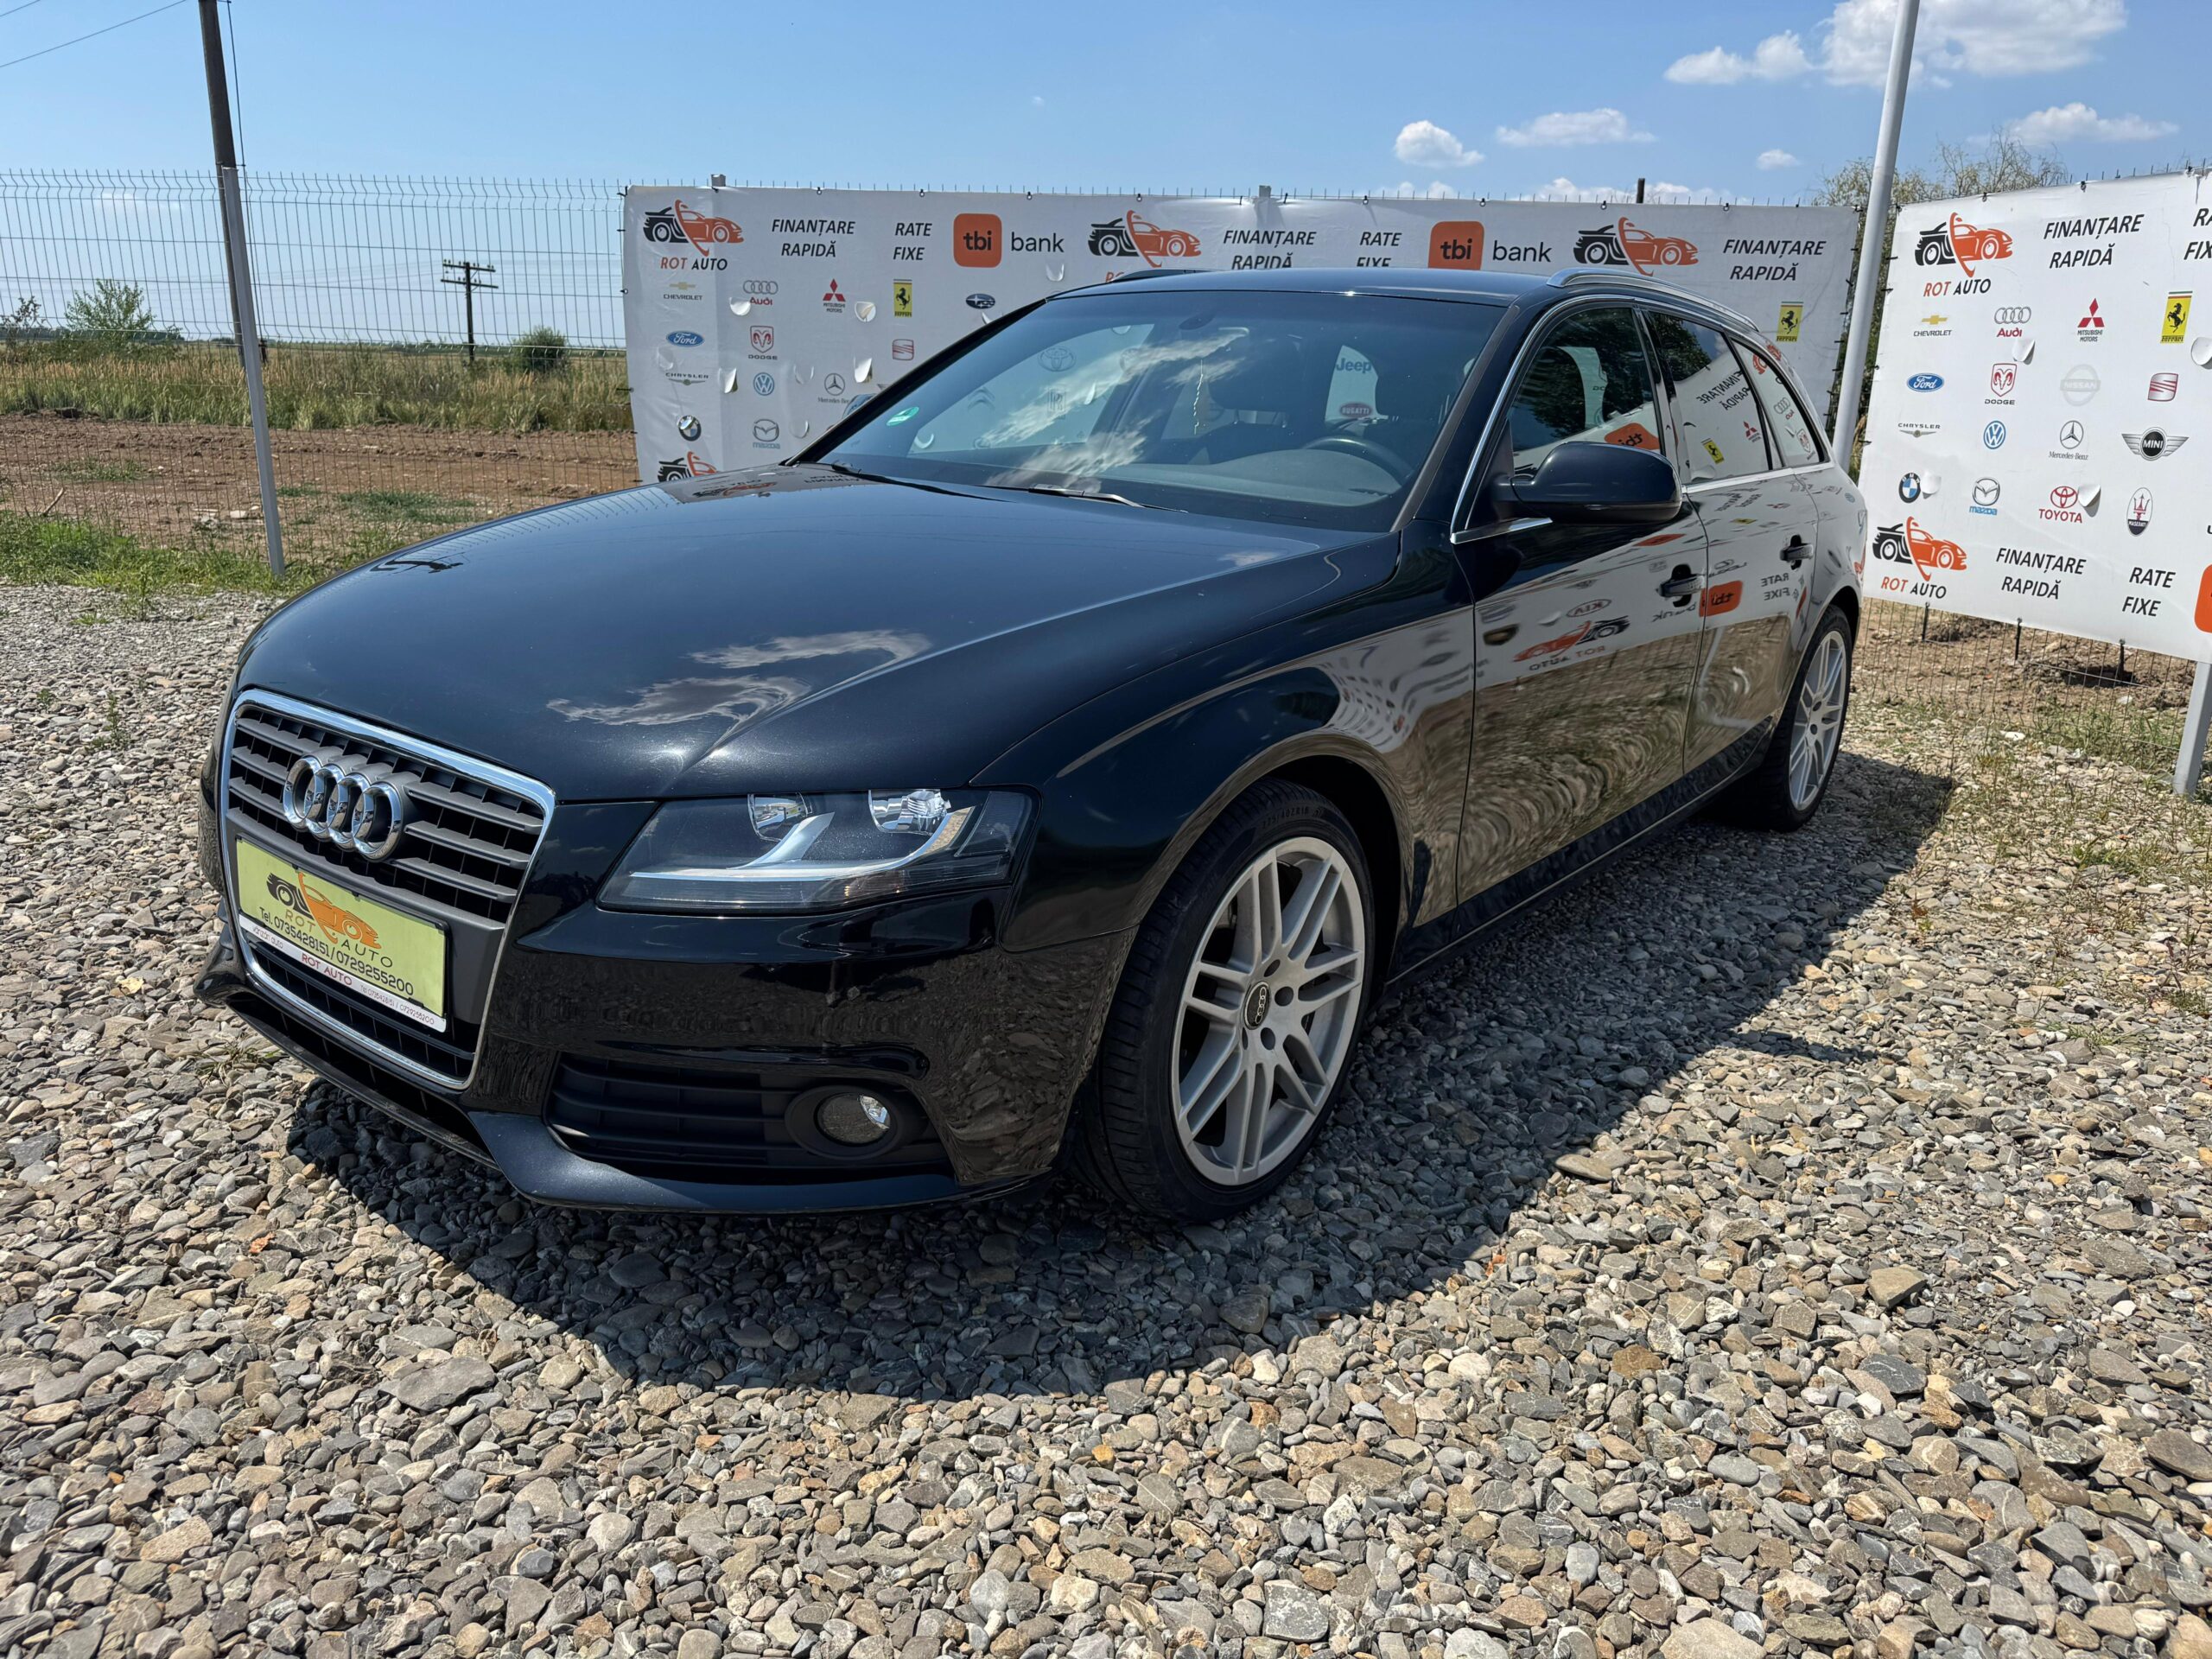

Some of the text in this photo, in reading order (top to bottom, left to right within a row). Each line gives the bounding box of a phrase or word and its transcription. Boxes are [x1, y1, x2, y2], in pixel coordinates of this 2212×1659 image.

[772, 219, 855, 237] FINANȚARE
[895, 222, 932, 237] RATE
[2044, 214, 2145, 239] FINANȚARE
[781, 240, 836, 257] RAPIDĂ
[963, 231, 1065, 253] tbi bank
[1224, 230, 1316, 248] FINANȚARE
[1359, 232, 1402, 247] RATE
[1723, 238, 1826, 259] FINANȚARE
[893, 246, 925, 261] FIXE
[1440, 238, 1552, 263] tbi bank
[2049, 243, 2115, 269] RAPIDĂ
[2183, 241, 2212, 260] FIX
[660, 257, 728, 270] ROT AUTO
[1231, 251, 1293, 270] RAPIDĂ
[1730, 262, 1798, 281] RAPIDĂ
[1923, 278, 1992, 297] ROT AUTO
[672, 332, 697, 346] Ford
[1997, 327, 2023, 338] Audi
[1336, 358, 1372, 374] Jeep
[1913, 375, 1936, 389] Ford
[2141, 439, 2164, 449] MINI
[2038, 508, 2083, 524] TOYOTA
[1995, 547, 2087, 575] FINANȚARE
[2128, 566, 2177, 588] RATE
[1880, 576, 1947, 600] ROT AUTO
[2001, 575, 2062, 600] RAPIDĂ
[2121, 595, 2162, 617] FIXE
[285, 909, 316, 932] ROT
[341, 939, 392, 968] AUTO
[302, 953, 353, 986] ROT AUTO
